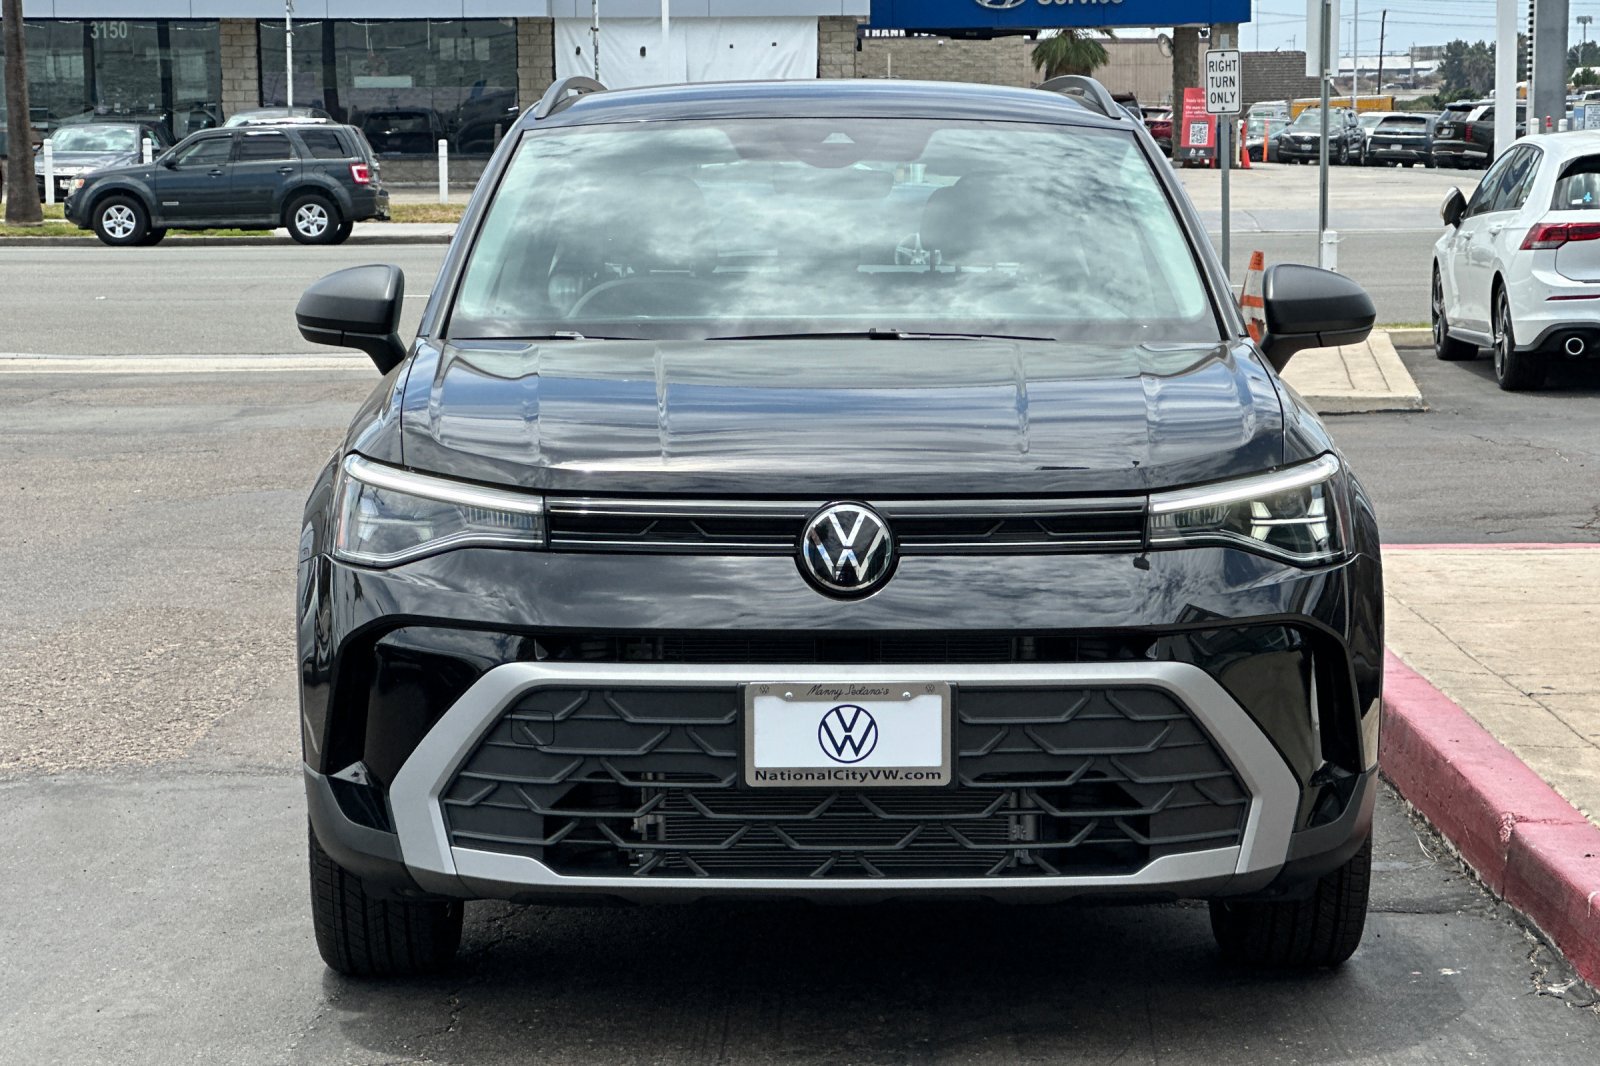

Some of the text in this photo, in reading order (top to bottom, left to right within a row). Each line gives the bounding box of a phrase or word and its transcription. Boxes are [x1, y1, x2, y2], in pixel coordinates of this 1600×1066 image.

[90, 21, 127, 38] 3150
[1209, 60, 1237, 72] RIGHT
[1210, 76, 1236, 88] TURN
[1210, 91, 1236, 104] ONLY
[806, 684, 843, 700] Manny
[755, 770, 941, 783] NationalCityVW.com
